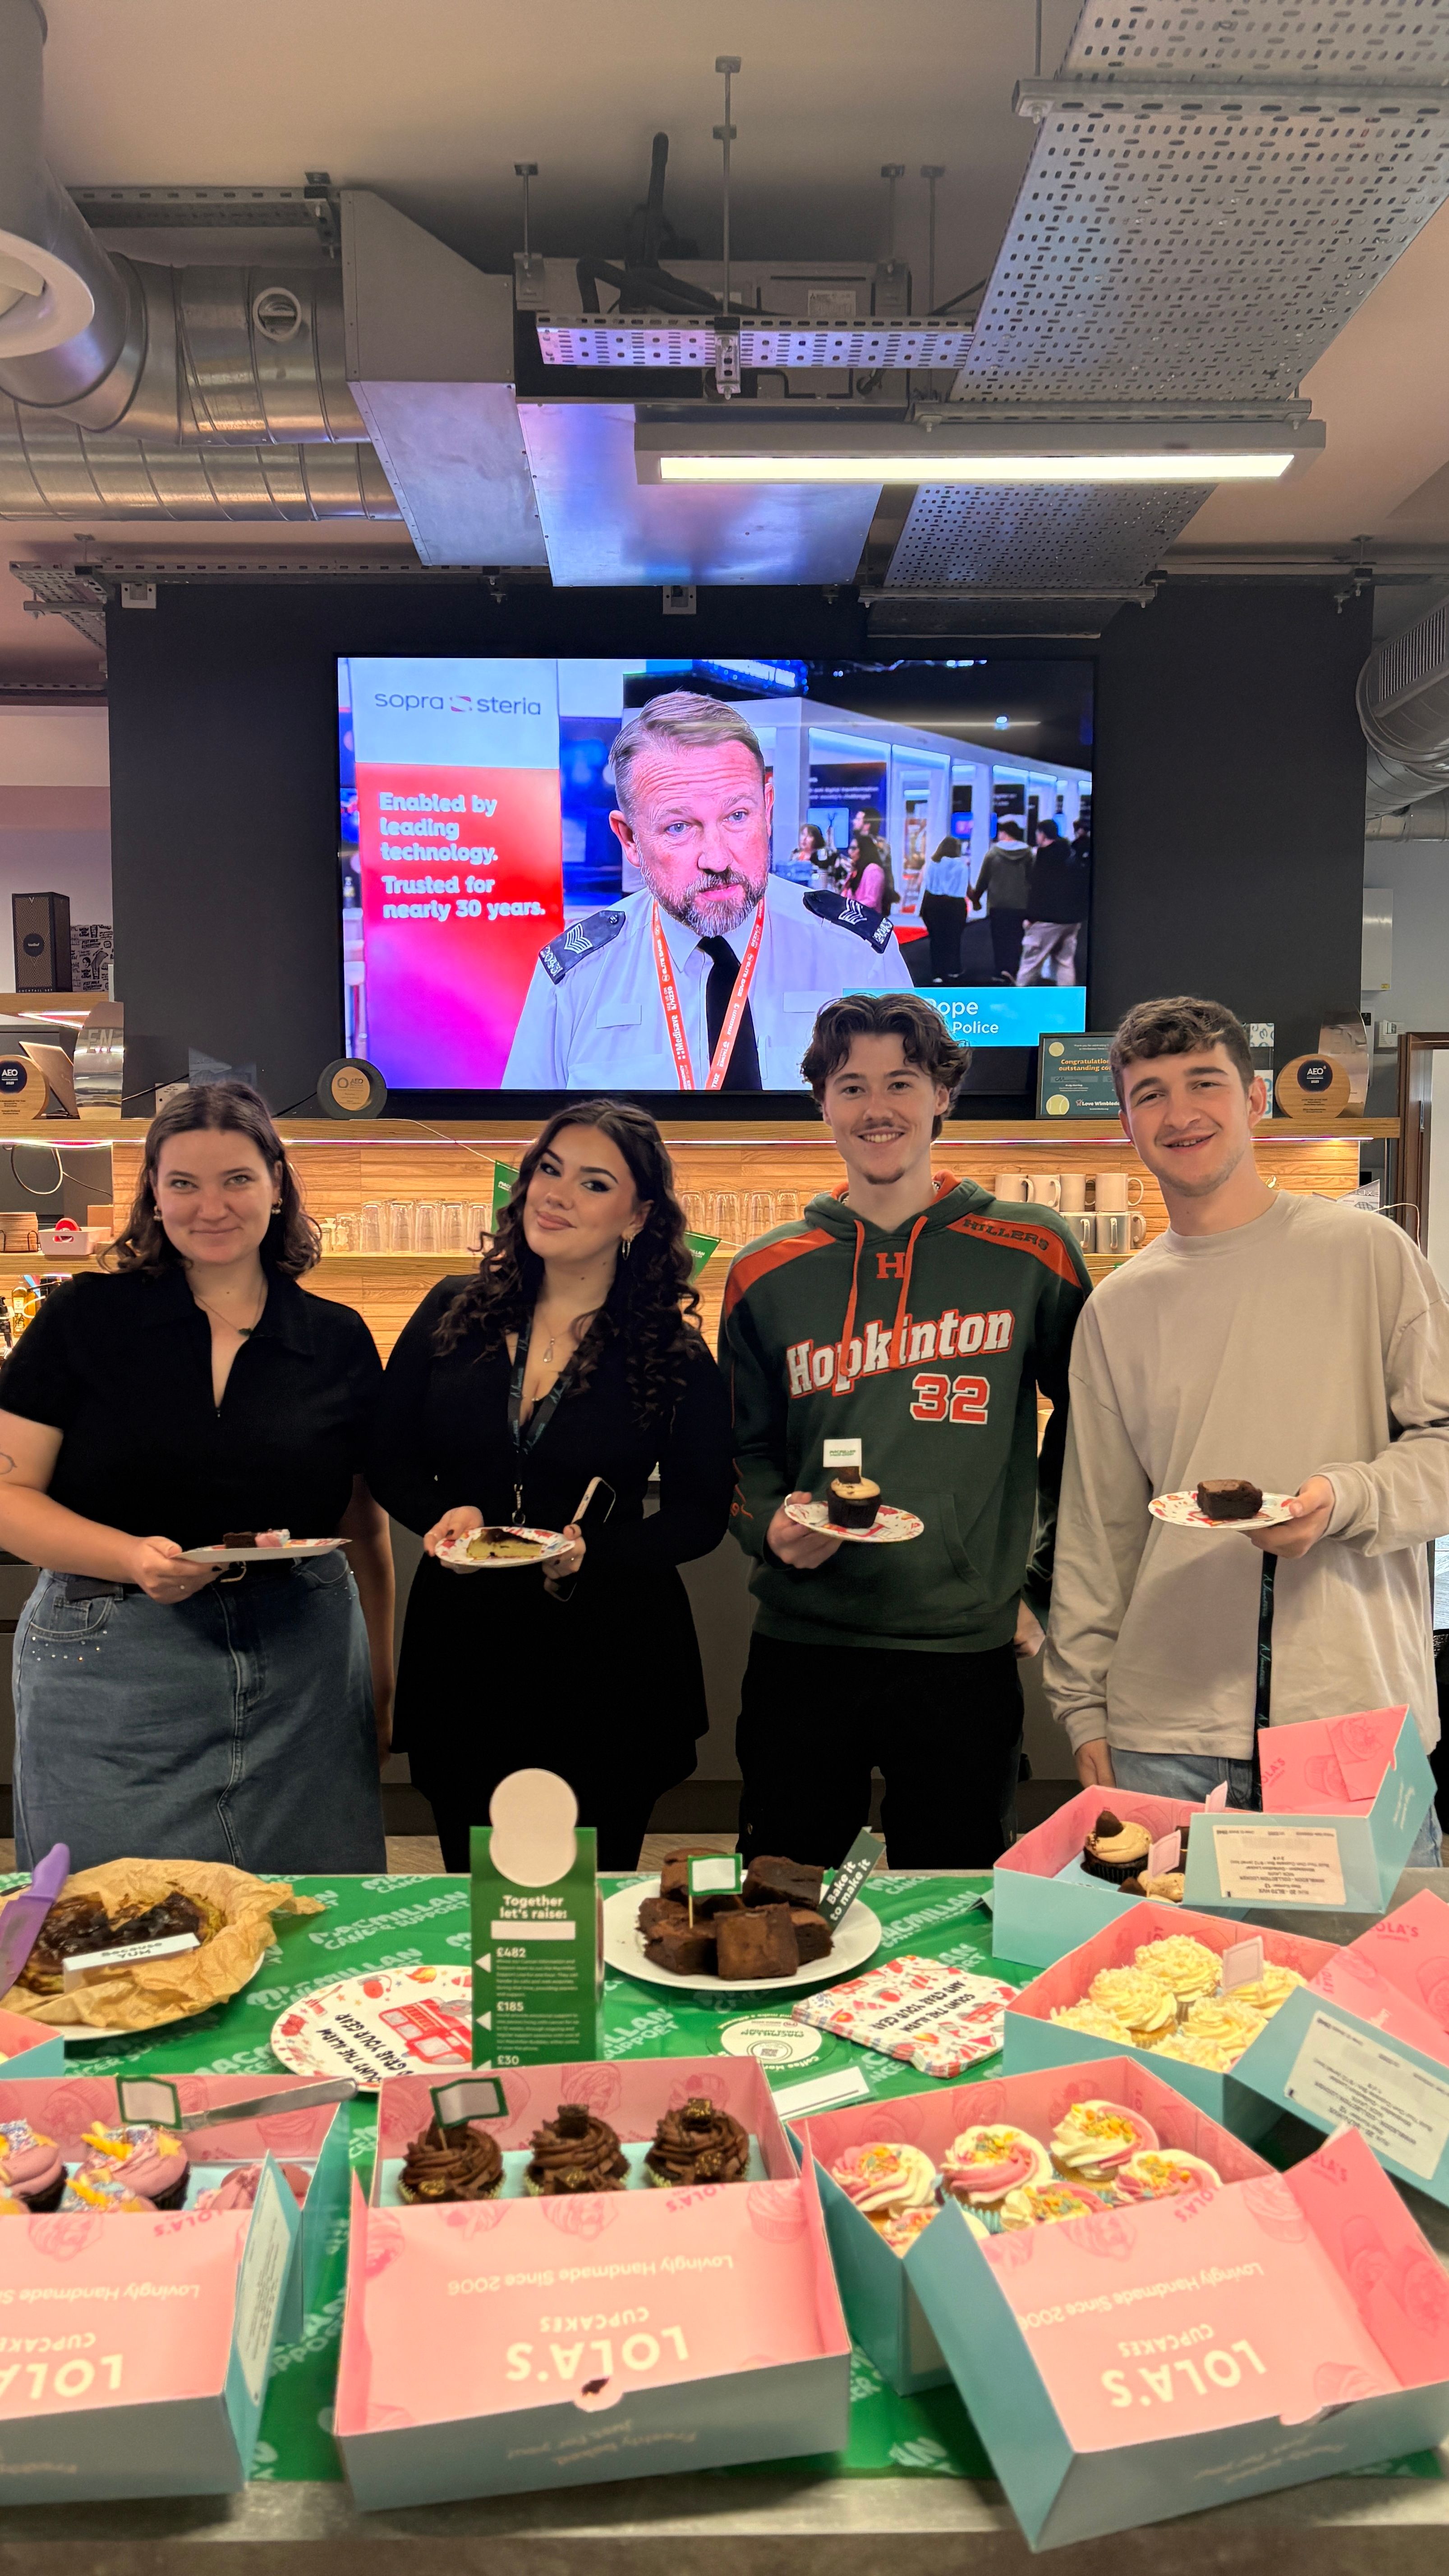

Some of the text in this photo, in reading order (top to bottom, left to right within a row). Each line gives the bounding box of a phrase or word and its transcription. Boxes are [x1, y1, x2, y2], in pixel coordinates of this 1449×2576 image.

[374, 691, 541, 716] sopra steria
[379, 792, 497, 817] Enabled by
[380, 818, 460, 841] leading
[381, 842, 498, 866] technology.
[382, 876, 495, 894] Trusted for
[383, 901, 545, 921] nearly 30 years.
[672, 1015, 684, 1051] Medisave
[952, 1021, 999, 1035] Police
[962, 1219, 1050, 1251] HILLERS
[877, 1252, 906, 1279] H
[786, 1309, 1016, 1398] Hopkinton
[910, 1373, 990, 1425] 32
[1261, 1758, 1285, 1784] OLA'S
[826, 1860, 856, 1905] Bake it
[830, 1858, 871, 1922] to make it
[499, 1907, 567, 1920] let's raise:
[502, 1895, 564, 1909] Together
[308, 1891, 468, 1944] MACMILLAN
[881, 1891, 981, 1940] ACMILLAN
[1375, 1922, 1419, 1938] OLA'S
[497, 1947, 526, 1959] £482
[497, 2001, 524, 2012] £185
[335, 2014, 407, 2075] GRAB YOUR GEAR
[337, 2045, 361, 2069] THE
[353, 2063, 382, 2084] OUND
[497, 2055, 520, 2066] £30
[666, 2183, 726, 2213] OLA'S
[154, 2209, 222, 2237] OLA'S
[448, 2255, 733, 2295] Lovingly Handmade Since 2006
[1199, 2262, 1264, 2287] Lovingly
[19, 2282, 200, 2302] Lovingly Handmade
[1065, 2295, 1113, 2313] Since
[1112, 2277, 1200, 2306] Handmade
[539, 2306, 650, 2333] CUPCAKES
[0, 2332, 97, 2353] CUPCAKE
[505, 2326, 690, 2381] LOLA'S
[1118, 2324, 1214, 2358] CUPCAKES
[0, 2354, 123, 2399] LOLA
[1100, 2339, 1266, 2407] LOLA'S
